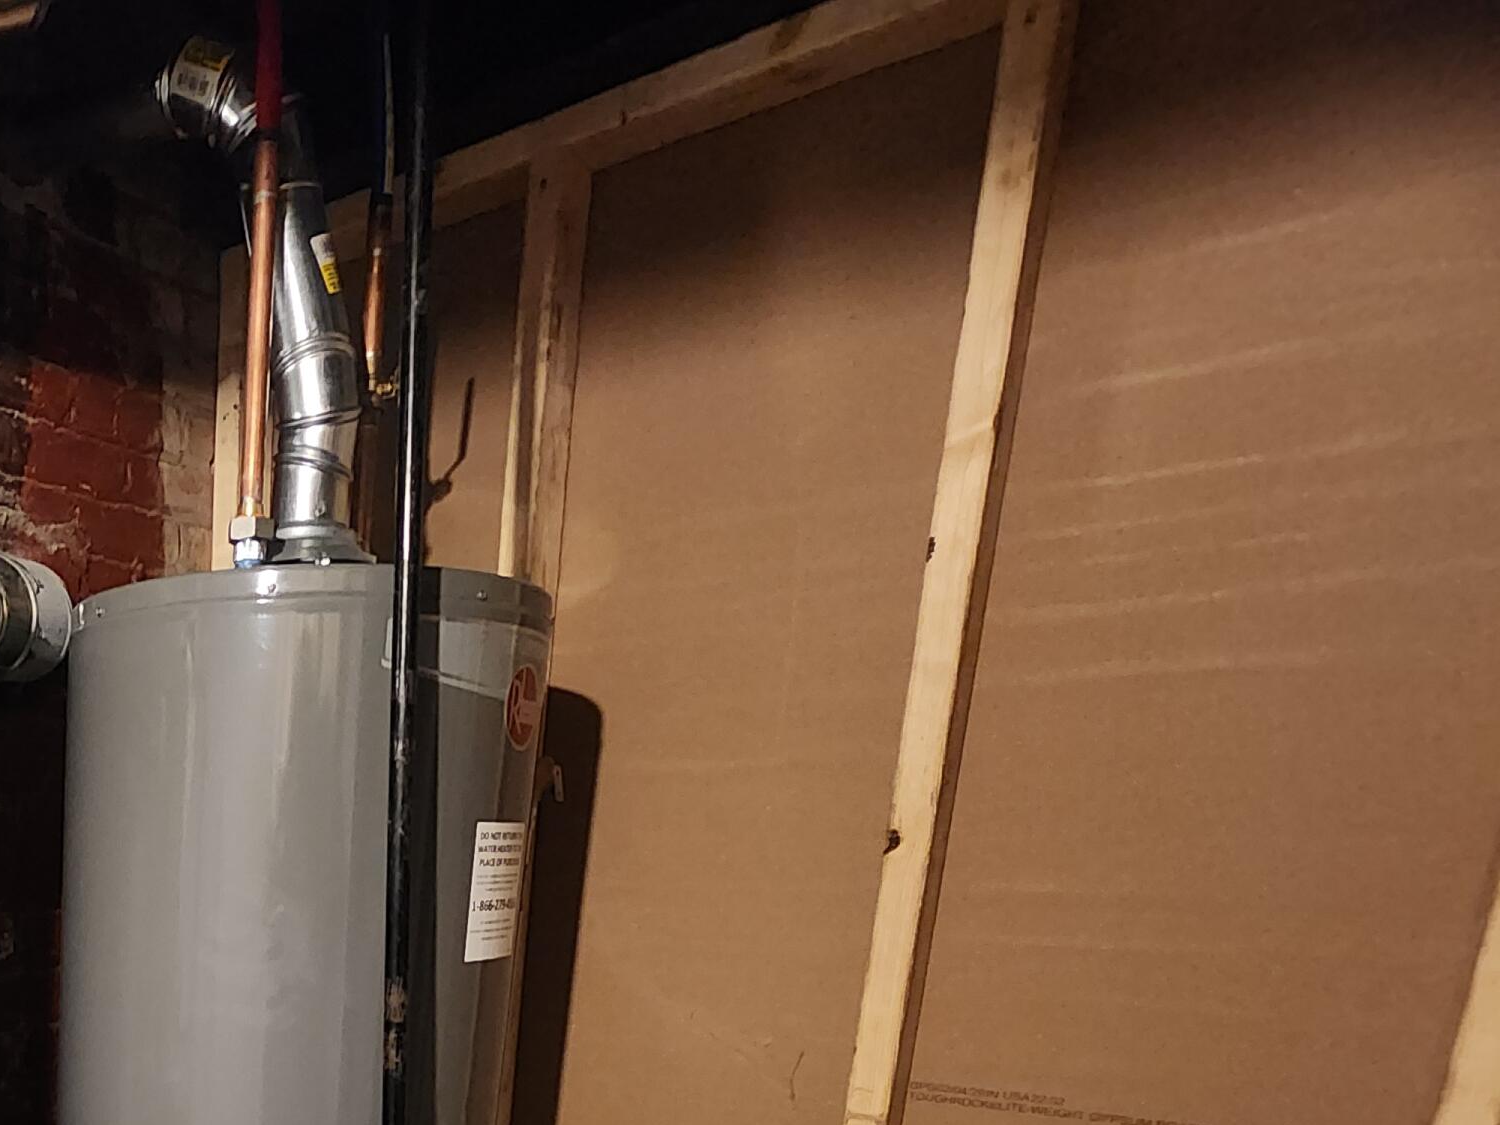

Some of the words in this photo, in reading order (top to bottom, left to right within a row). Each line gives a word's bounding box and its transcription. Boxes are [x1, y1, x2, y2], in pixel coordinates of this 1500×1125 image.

[480, 831, 489, 840] DO
[490, 831, 501, 840] NOT
[479, 857, 495, 866] PLACE
